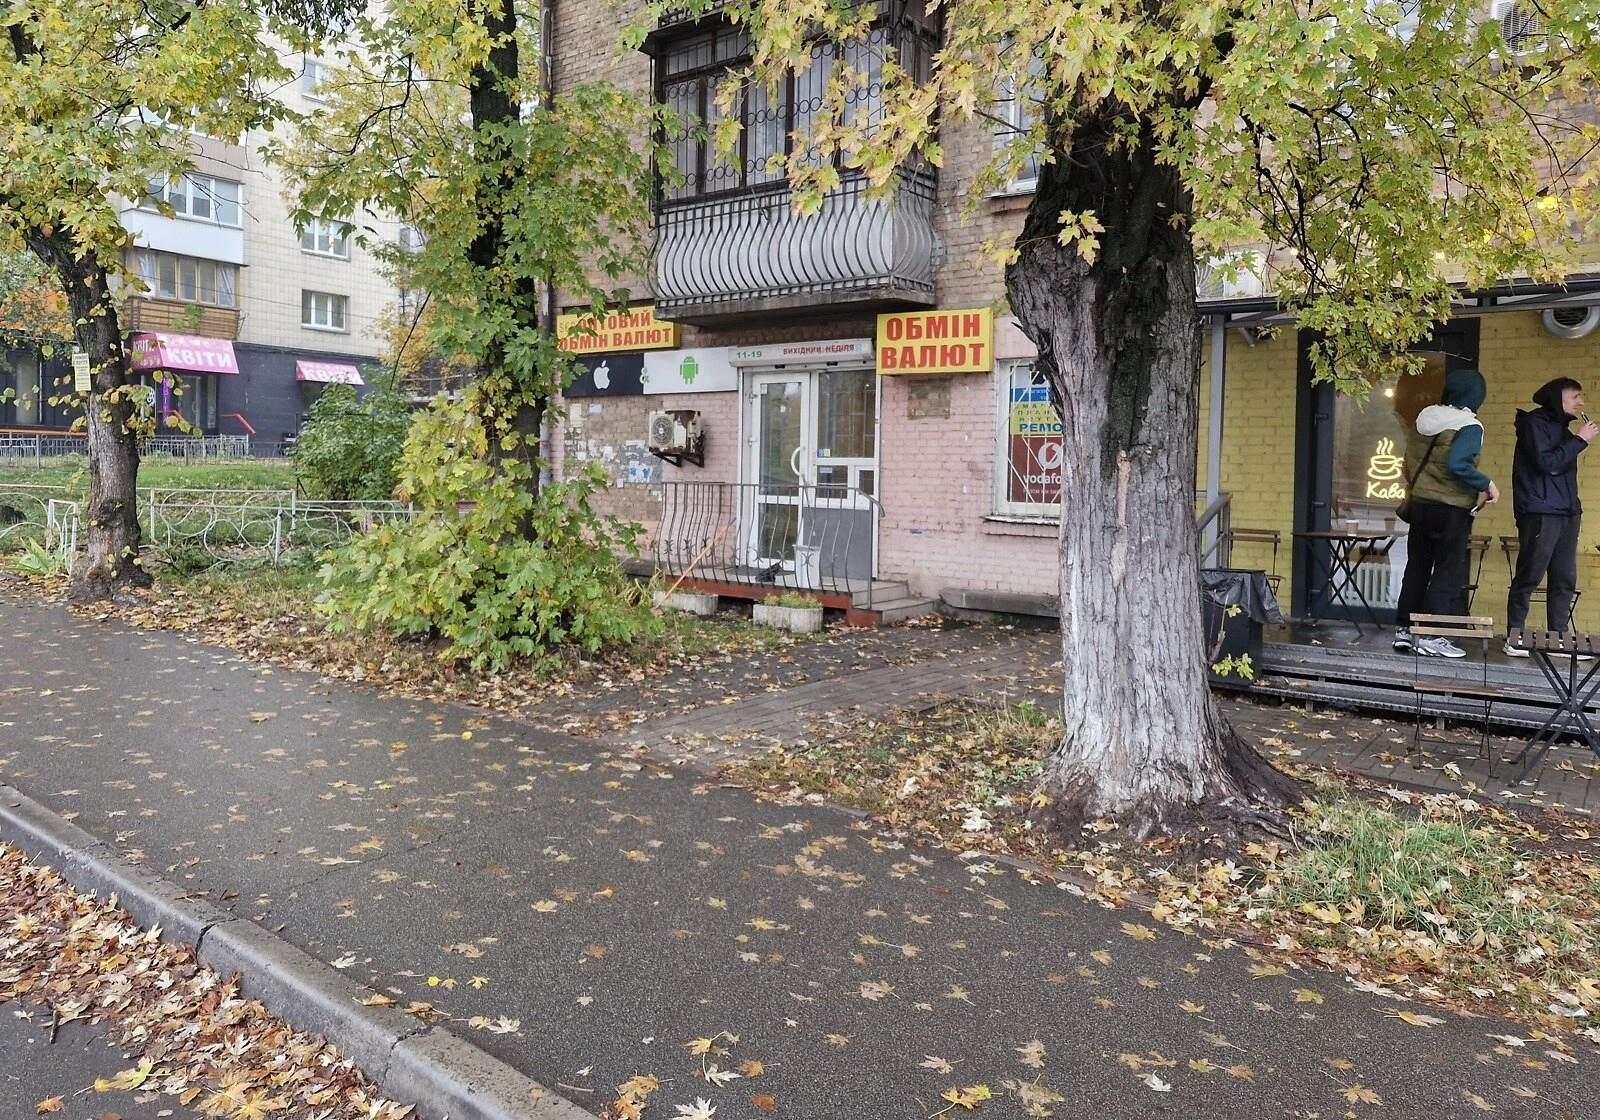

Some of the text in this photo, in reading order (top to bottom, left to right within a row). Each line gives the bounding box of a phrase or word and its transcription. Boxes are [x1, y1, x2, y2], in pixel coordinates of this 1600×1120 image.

[886, 313, 980, 341] ОБМІН
[559, 328, 671, 351] ОБМІН ВАЛЮТ
[166, 348, 233, 367] КВІТИ
[736, 350, 762, 358] 11-19
[783, 344, 855, 355] ВИХІДНИЙ НЕДІЛЯ
[881, 343, 985, 369] ВАЛЮТ
[1366, 481, 1405, 499] Кава
